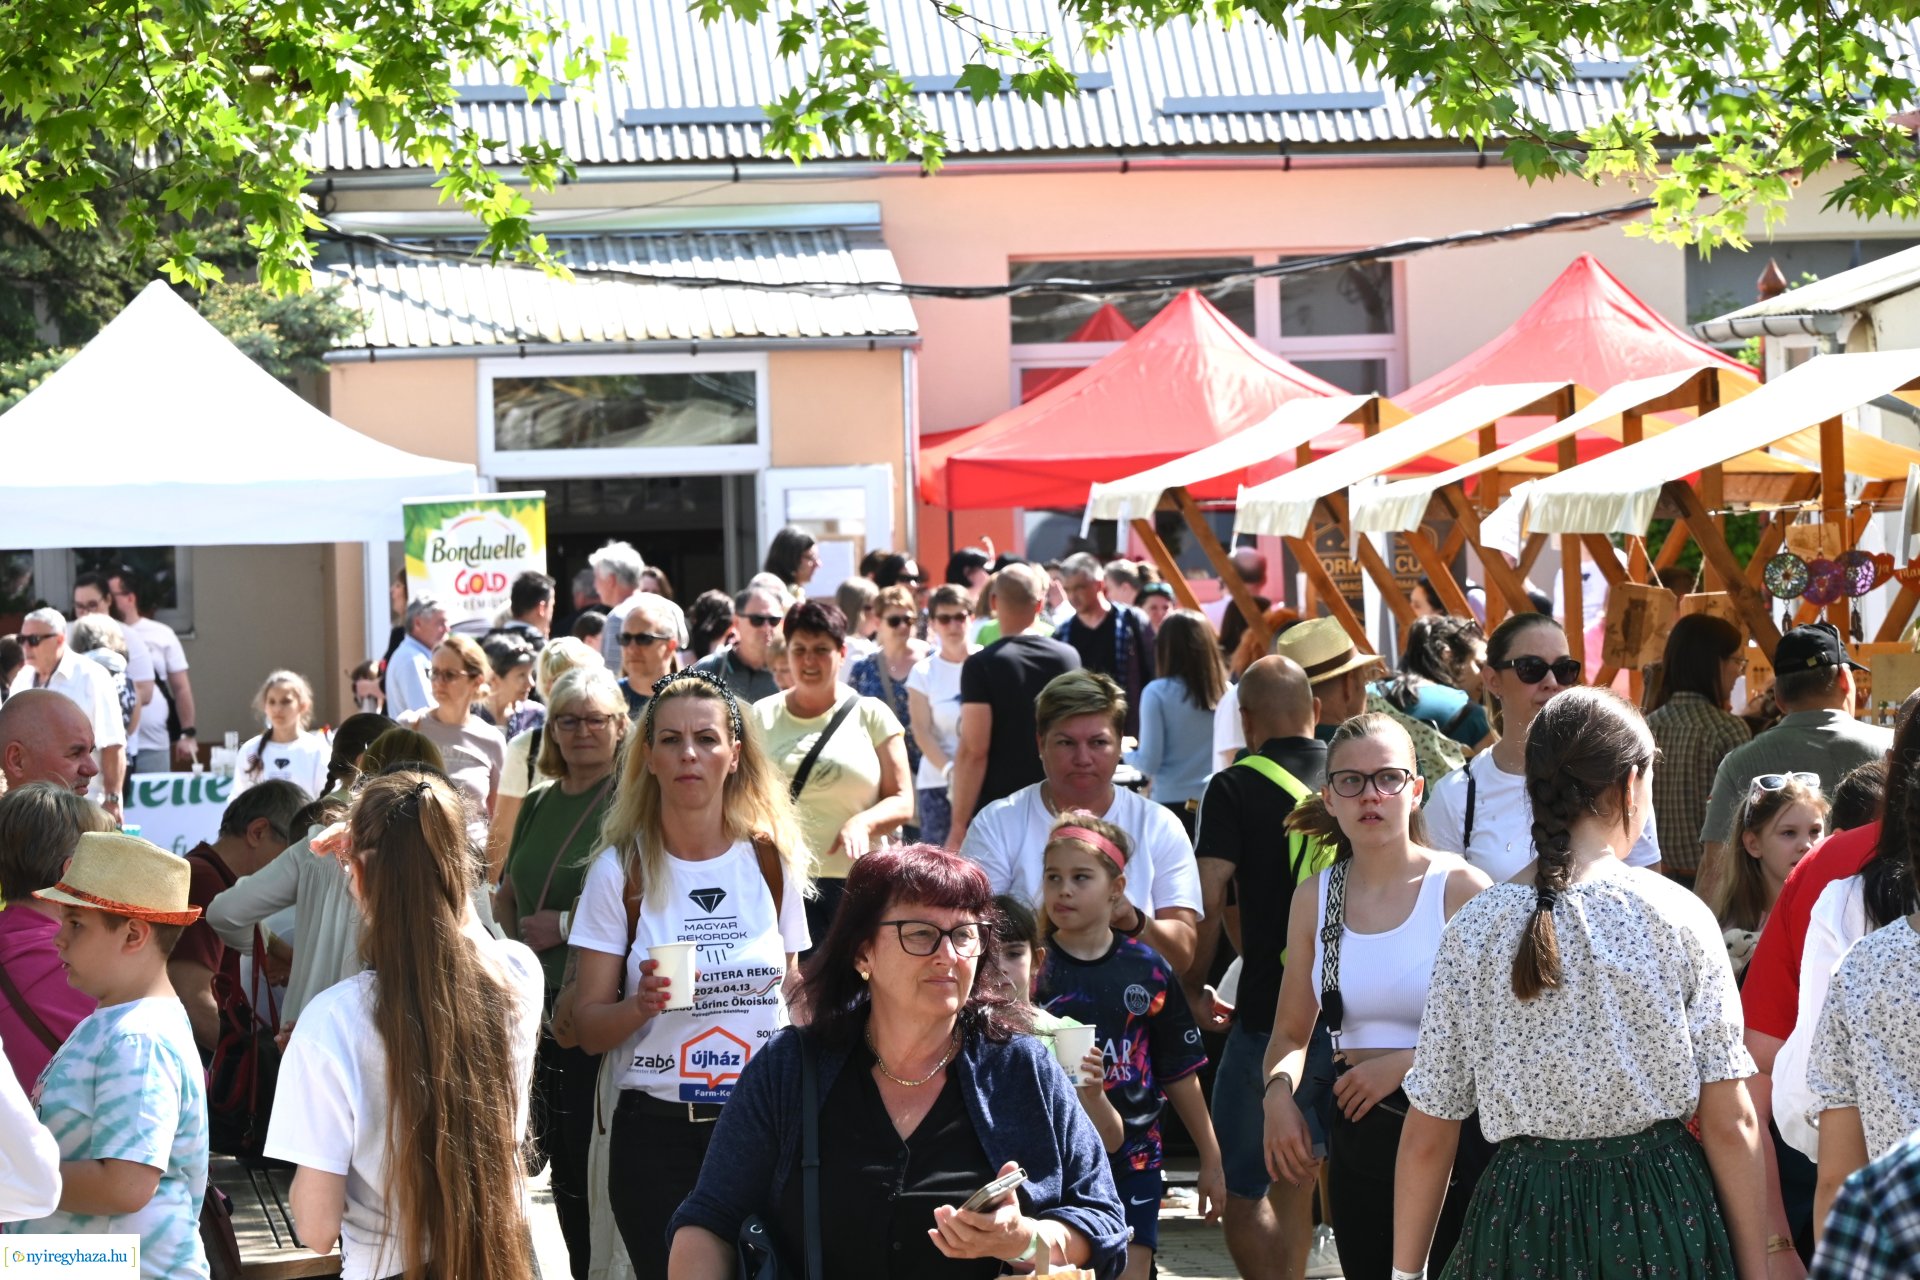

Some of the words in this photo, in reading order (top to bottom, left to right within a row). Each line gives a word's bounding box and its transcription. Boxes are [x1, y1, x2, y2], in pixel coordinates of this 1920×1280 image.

[432, 534, 526, 568] Bonduelle
[455, 569, 507, 595] GOLD
[123, 776, 234, 809] elle
[684, 921, 738, 931] MAGYAR
[677, 931, 748, 942] REKORDOK
[702, 969, 744, 982] CITERA
[694, 983, 750, 996] 2024.04.13
[630, 1053, 675, 1075] zabó
[691, 1050, 740, 1068] újház
[694, 1089, 731, 1098] Farm-Ke
